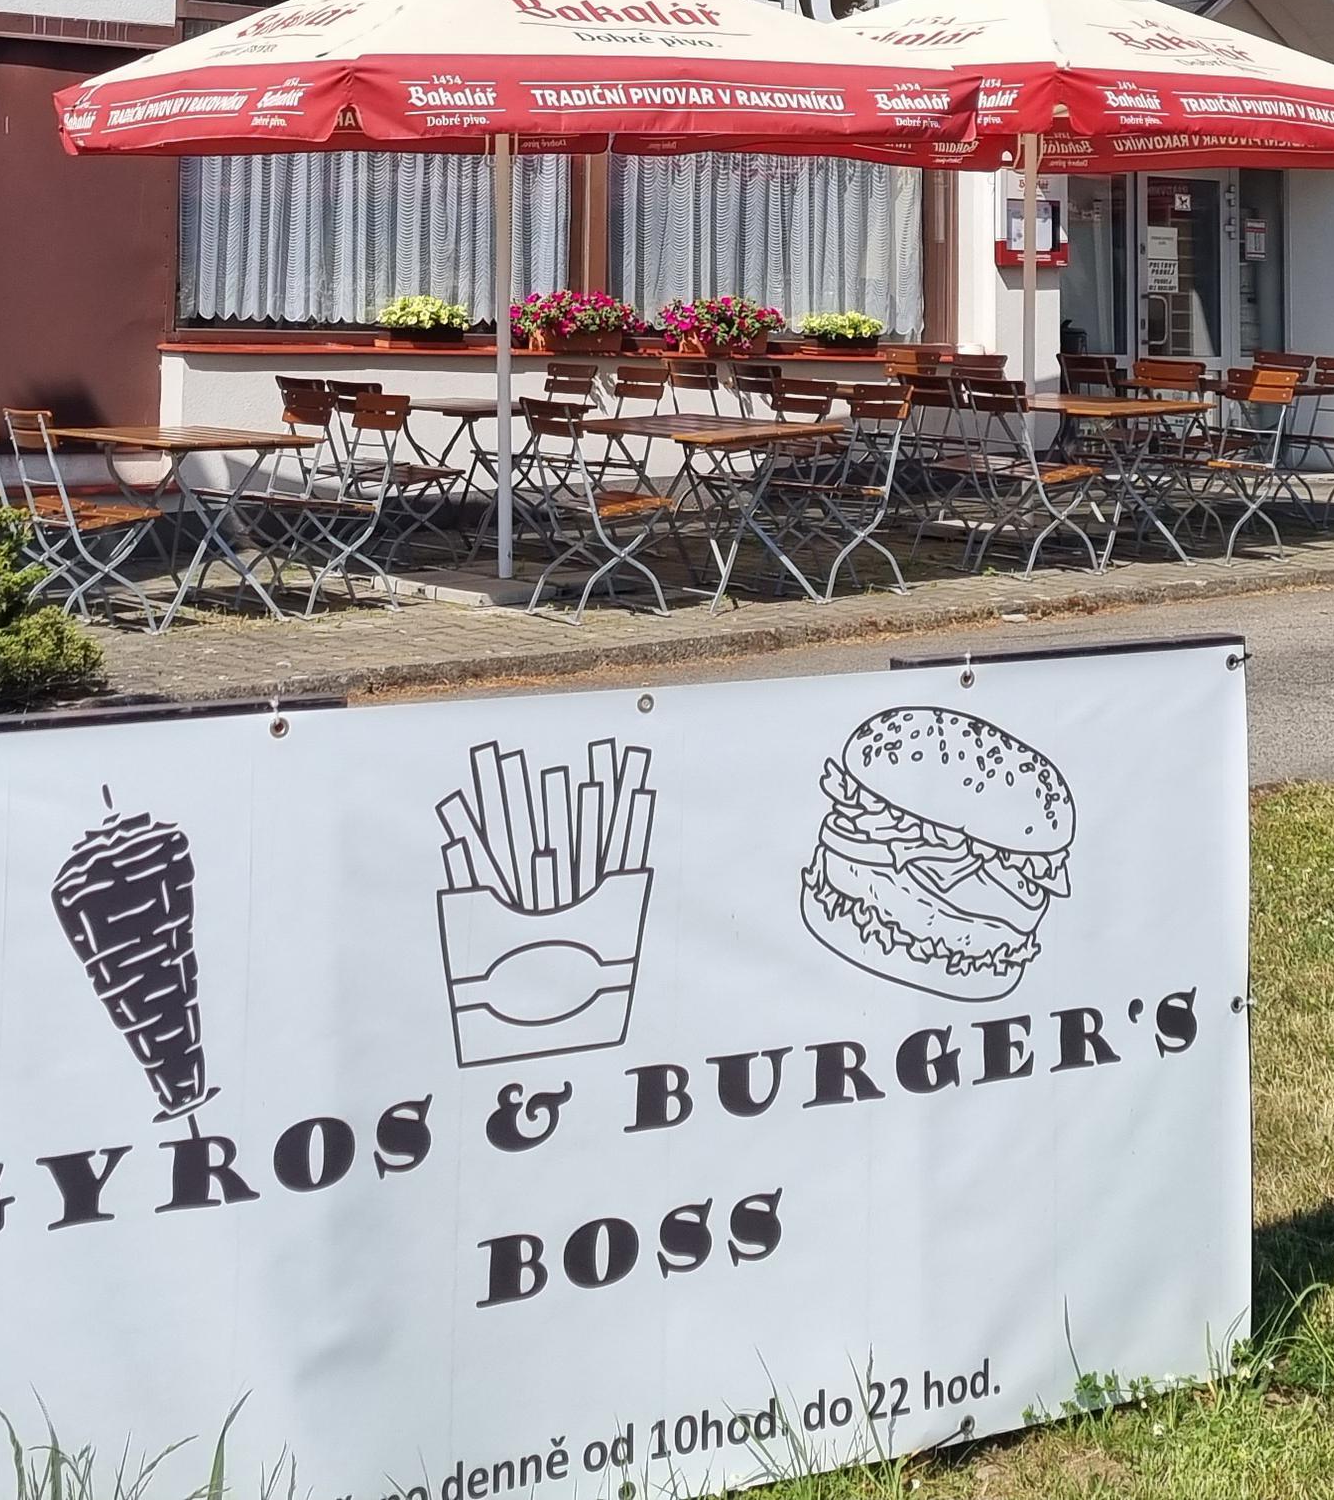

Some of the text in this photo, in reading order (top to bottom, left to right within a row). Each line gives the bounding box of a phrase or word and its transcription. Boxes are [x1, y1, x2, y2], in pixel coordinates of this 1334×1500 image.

[572, 32, 722, 47] Dobré pivo.
[432, 75, 462, 84] 1454
[408, 86, 497, 106] Bakalář
[531, 84, 844, 111] TRADIČNÍ PIVOVAR V RAKOVNÍKU
[875, 93, 951, 110] Bakalář
[978, 90, 1019, 108] kalář
[1104, 91, 1161, 110] Bakalář
[1180, 96, 1243, 113] TRADIČNÍ
[1244, 100, 1296, 117] PIVOVAR
[1297, 105, 1306, 118] V
[426, 115, 490, 128] Dobré pivo.
[895, 117, 921, 127] Dobré
[485, 1081, 573, 1152] &
[623, 985, 1199, 1134] BURGER'S
[475, 1187, 784, 1309] BOSS
[441, 1357, 1002, 1500] denně od 10hod. do 22 hod.
